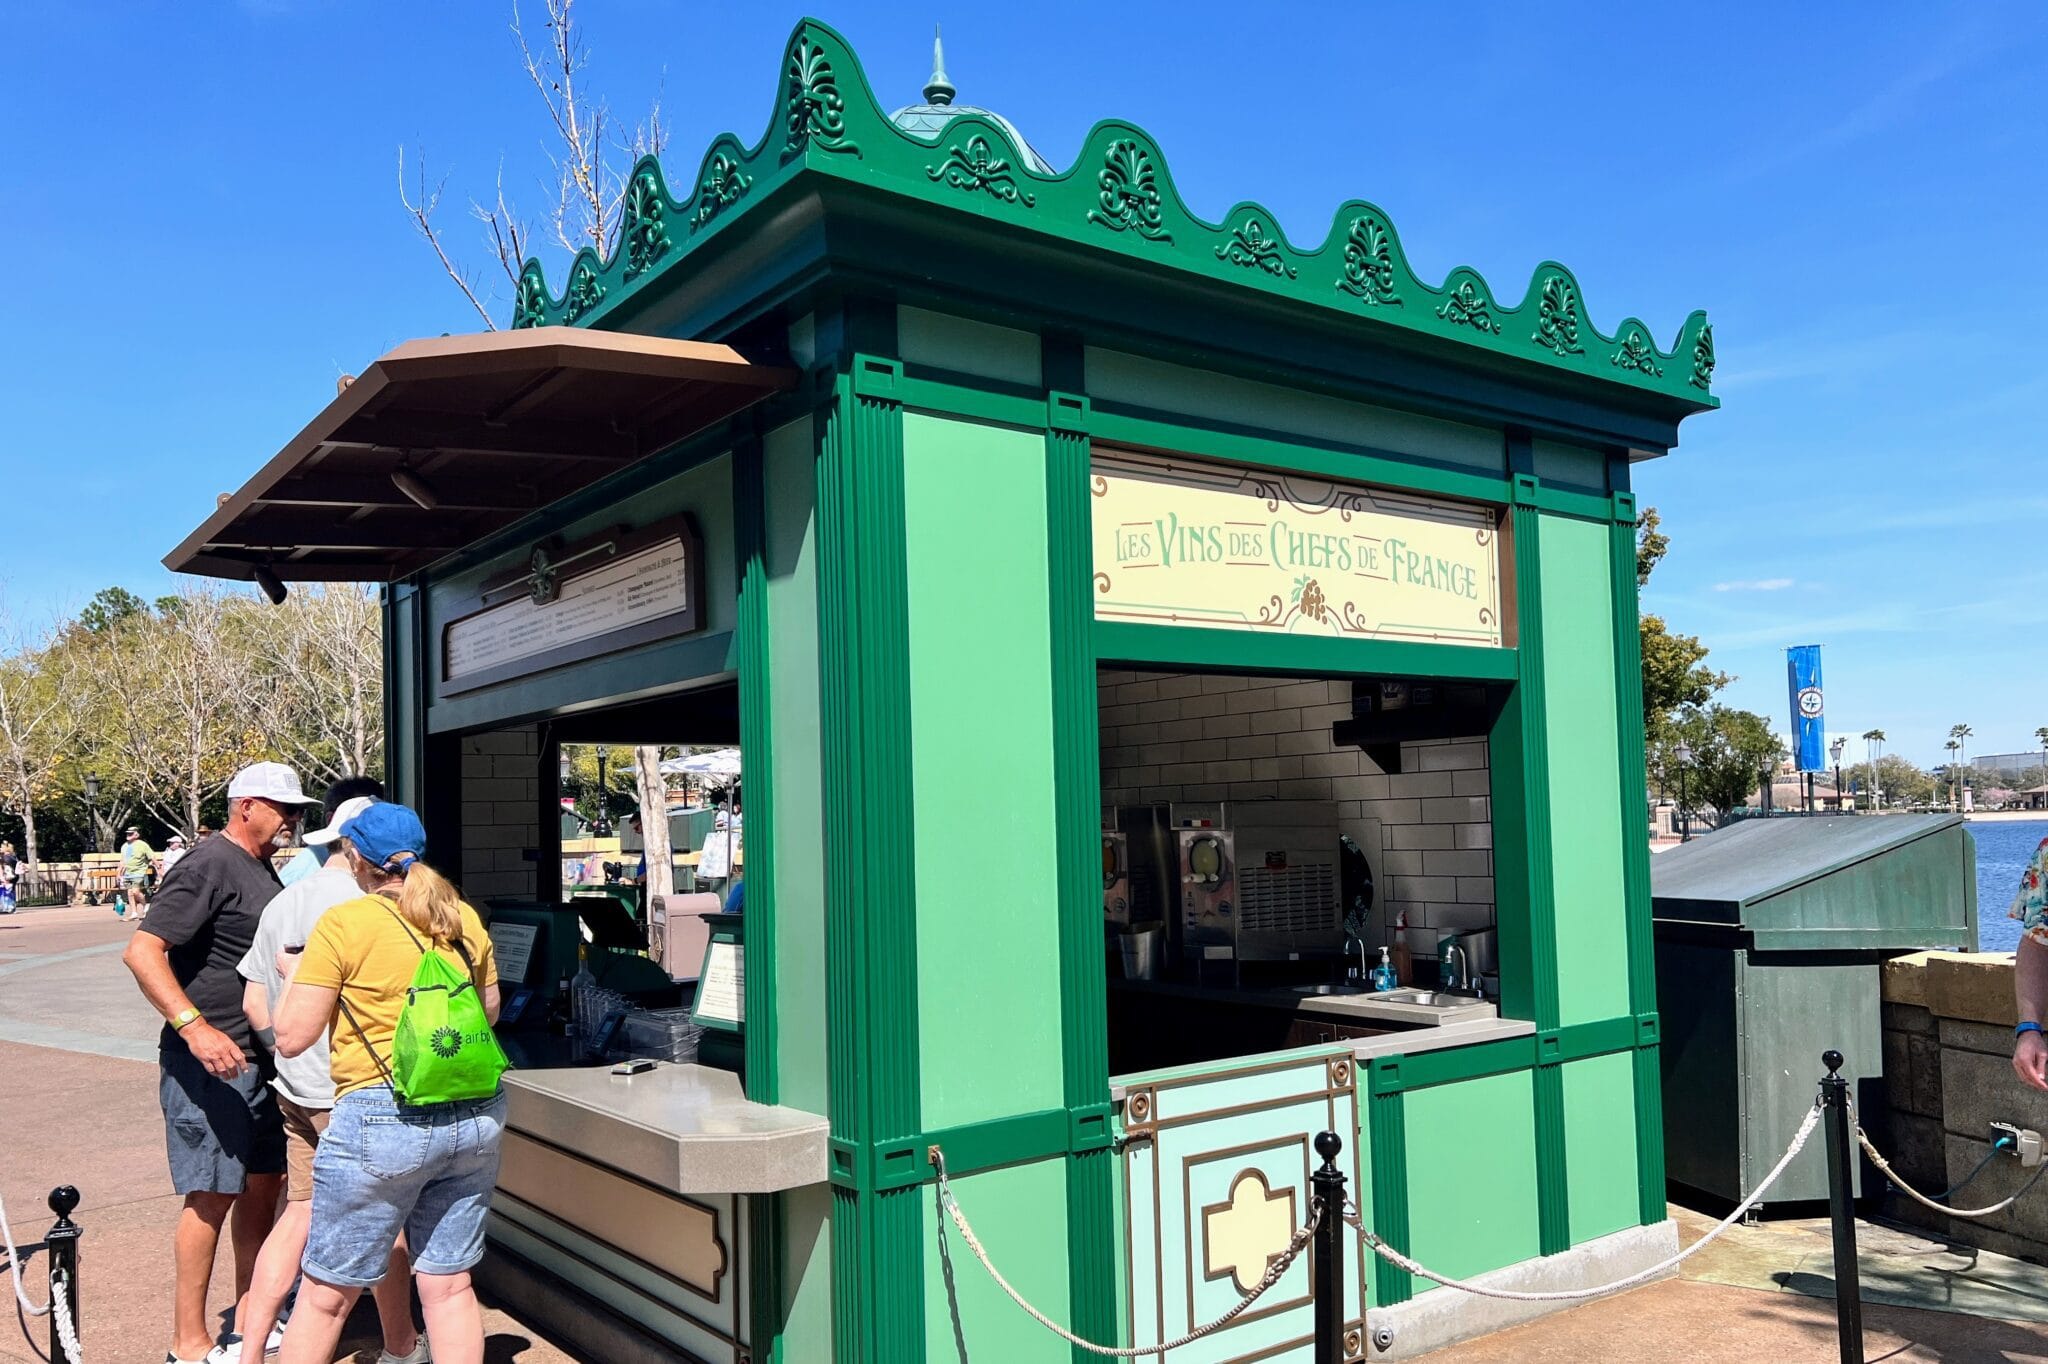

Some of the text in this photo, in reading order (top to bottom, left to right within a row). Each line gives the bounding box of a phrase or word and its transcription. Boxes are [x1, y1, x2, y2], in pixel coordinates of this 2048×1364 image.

[1115, 511, 1479, 601] LES VINS DES CHEFS DE FRANCE
[465, 1030, 479, 1044] air
